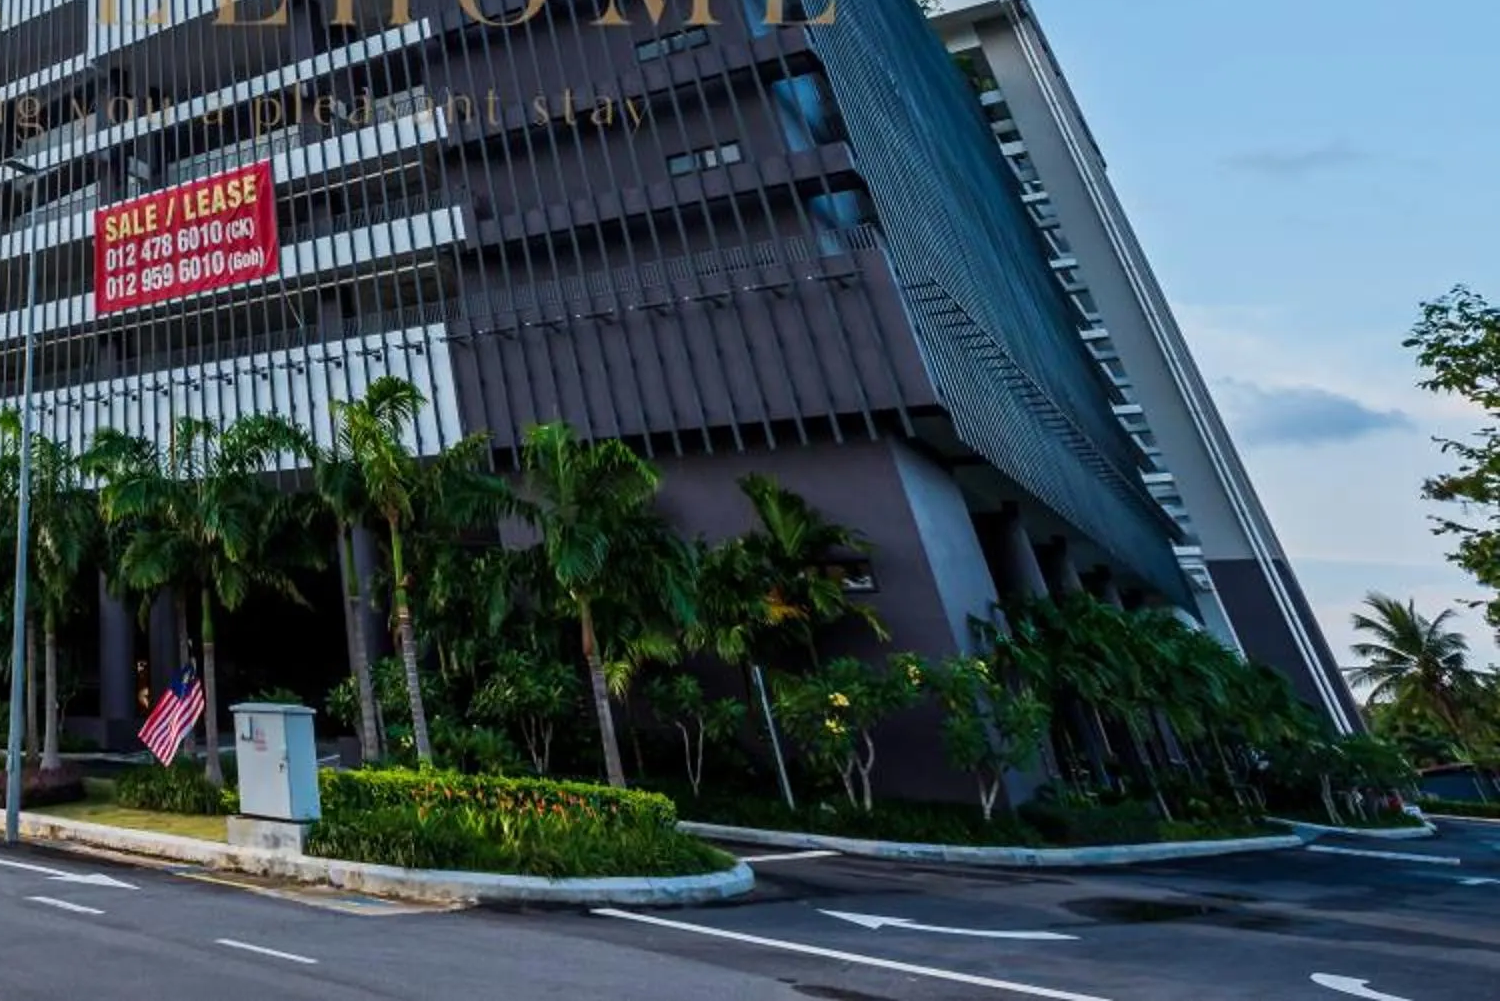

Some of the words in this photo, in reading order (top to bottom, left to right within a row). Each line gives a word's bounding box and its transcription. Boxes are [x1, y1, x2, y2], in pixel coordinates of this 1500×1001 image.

[105, 203, 158, 243] SALE
[164, 196, 175, 228] /
[183, 174, 258, 221] LEASE
[105, 242, 137, 272] 012
[141, 233, 173, 262] 478
[177, 219, 223, 253] 6010
[225, 216, 255, 245] (CK)
[105, 272, 137, 302] 012
[141, 262, 175, 292] 959
[179, 250, 226, 284] 6010
[228, 246, 265, 276] (Goh)
